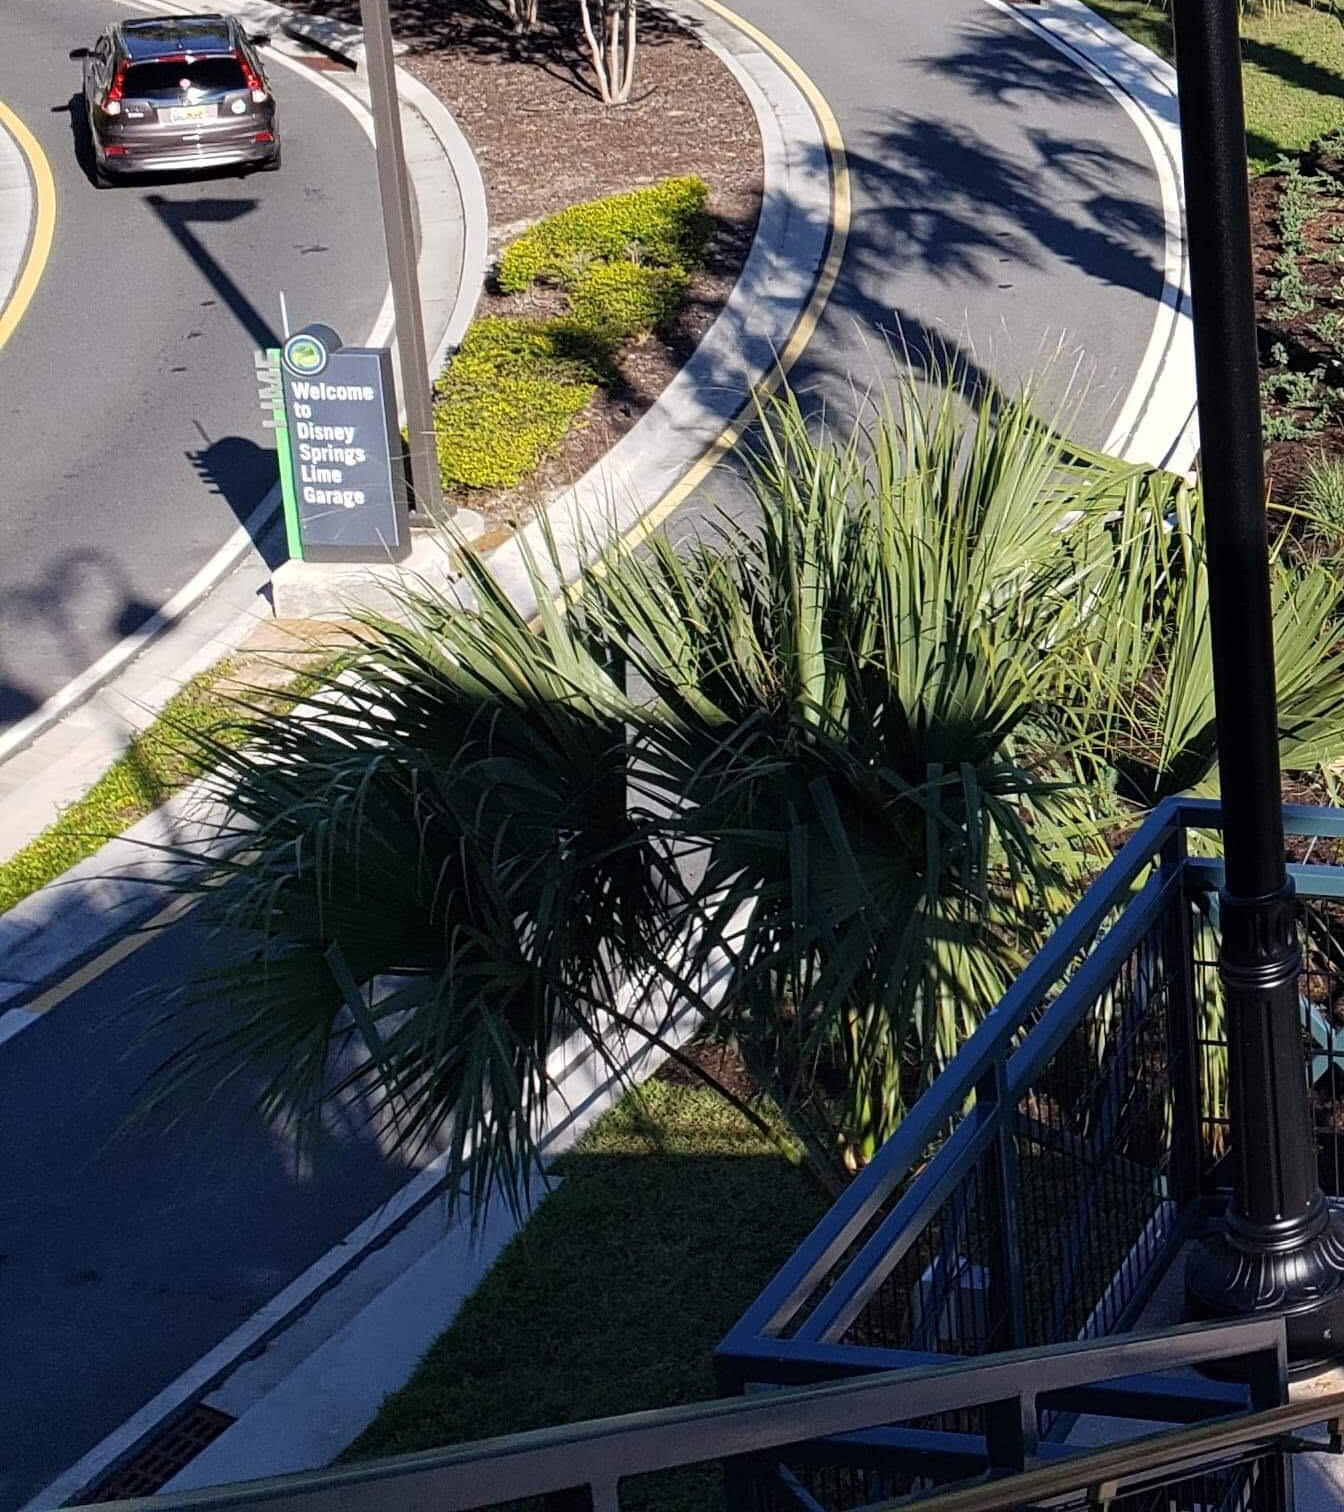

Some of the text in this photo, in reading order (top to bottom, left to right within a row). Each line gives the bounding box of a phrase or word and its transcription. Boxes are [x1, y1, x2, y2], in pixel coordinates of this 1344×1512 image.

[291, 381, 375, 401] Welcome
[293, 401, 312, 419] to
[296, 421, 355, 444] Disney
[299, 443, 366, 466] Springs
[301, 464, 342, 484] Lime
[303, 487, 365, 509] Garage
